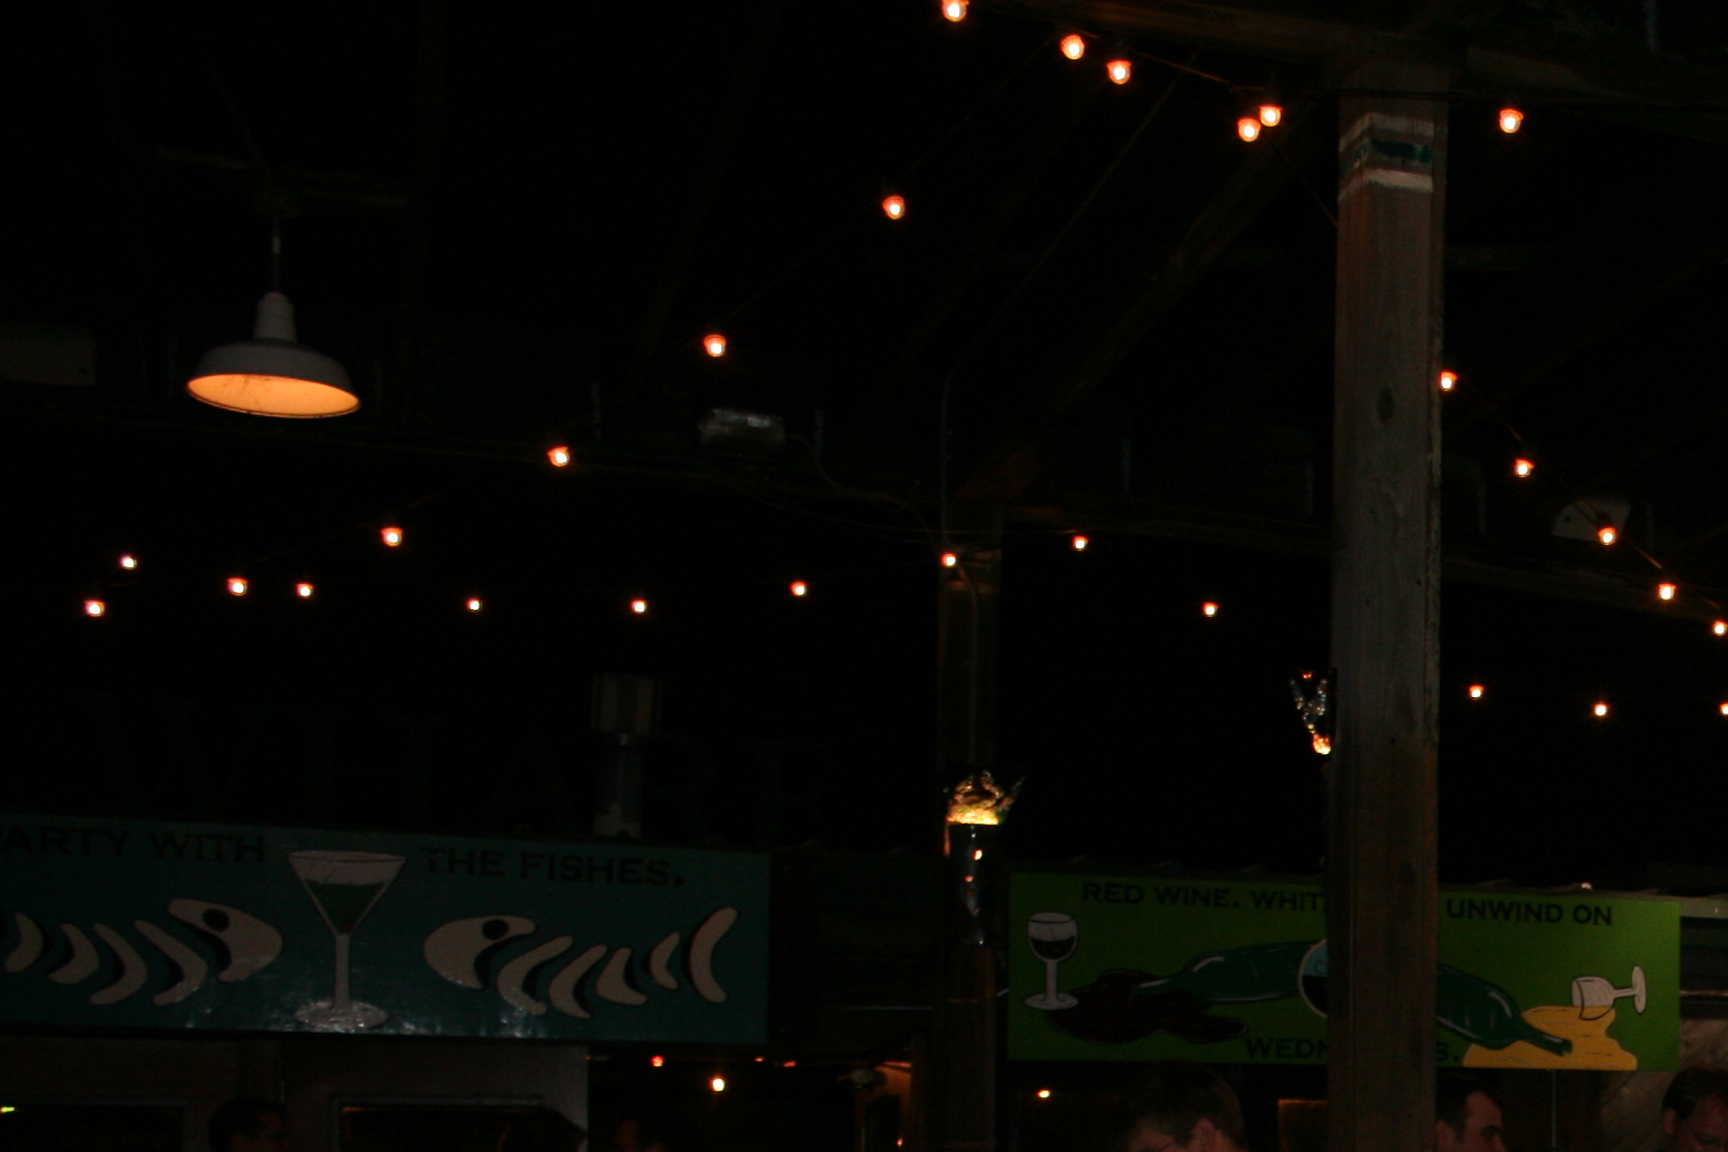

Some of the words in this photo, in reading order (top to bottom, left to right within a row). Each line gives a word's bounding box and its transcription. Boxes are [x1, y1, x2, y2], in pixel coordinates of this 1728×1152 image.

[0, 824, 131, 857] ARTY
[149, 832, 268, 864] WITH
[420, 846, 506, 878] THE
[519, 852, 686, 888] FISHES.
[1081, 882, 1146, 905] RED
[1154, 885, 1242, 909] WINE.
[1249, 889, 1328, 912] WHIT
[1446, 900, 1564, 924] UNWIND
[1573, 904, 1613, 926] ON
